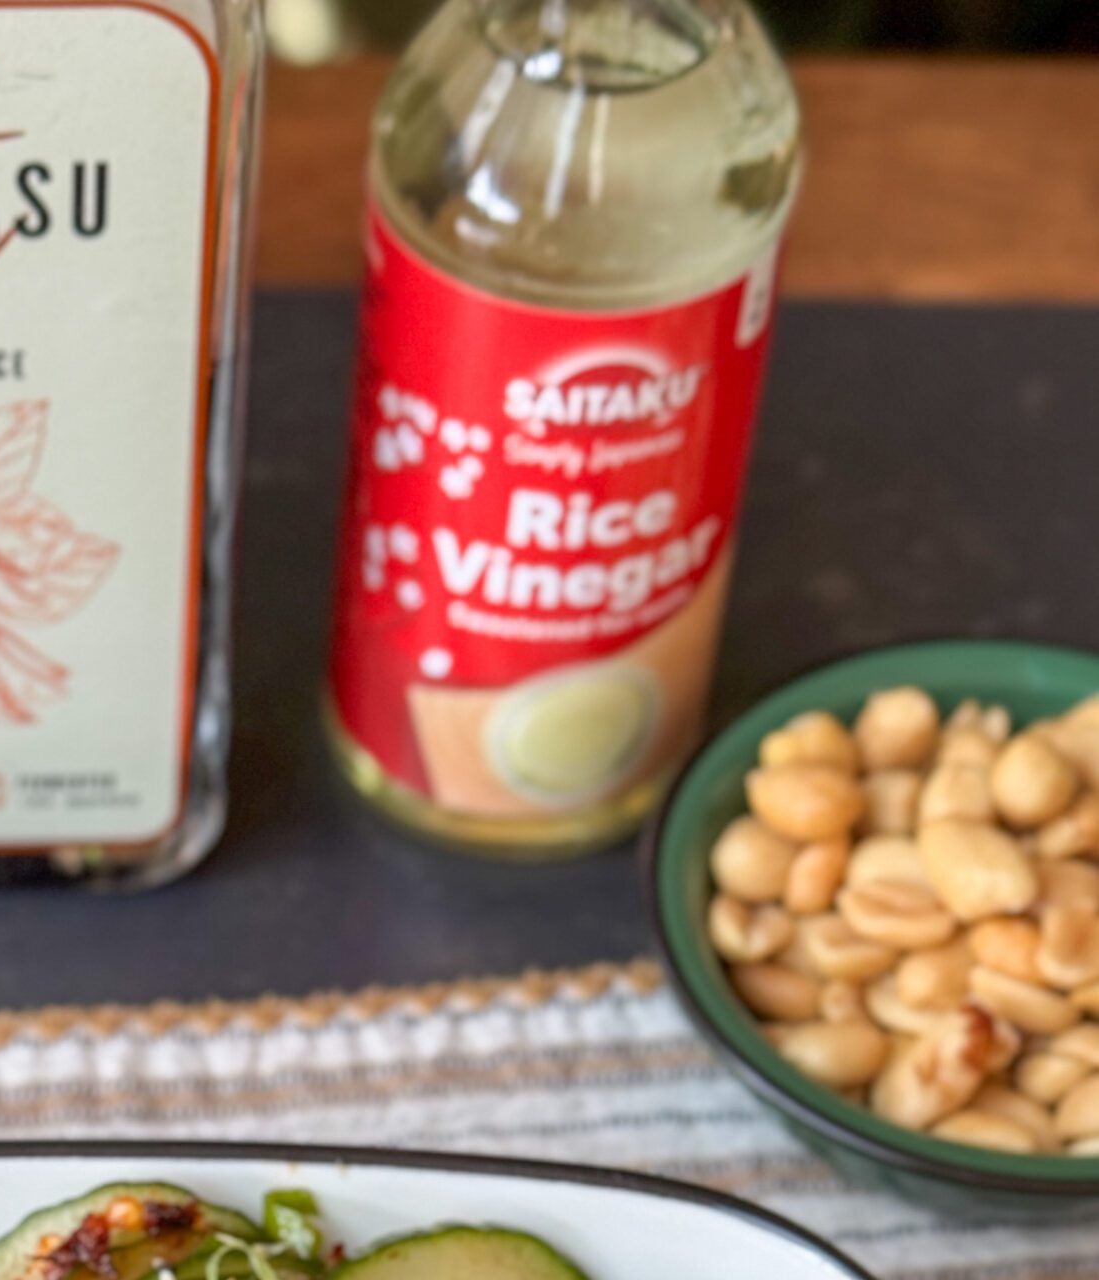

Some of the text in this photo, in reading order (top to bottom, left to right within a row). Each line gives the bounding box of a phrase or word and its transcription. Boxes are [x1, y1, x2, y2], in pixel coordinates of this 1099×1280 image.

[504, 366, 701, 430] SAITAKU
[507, 488, 677, 551] Rice
[432, 515, 720, 612] Vinegar
